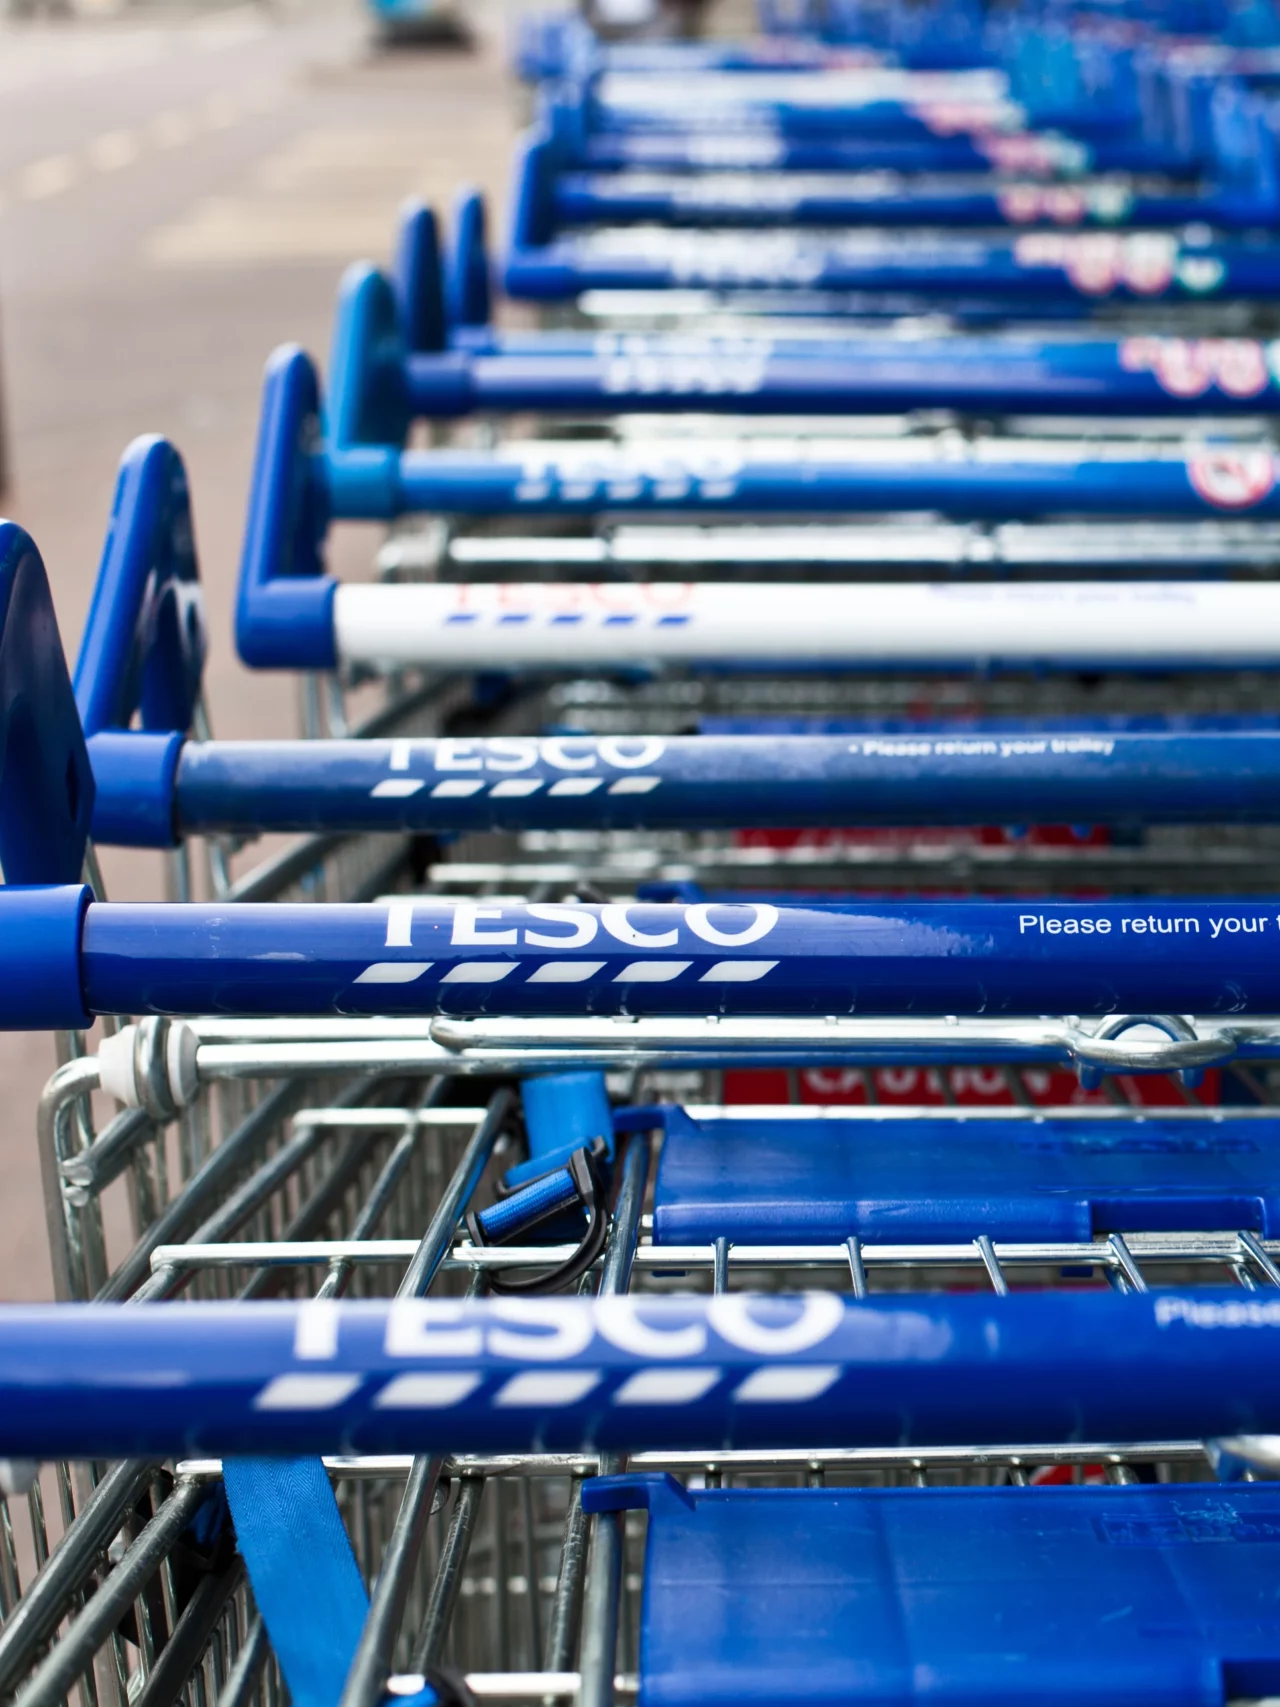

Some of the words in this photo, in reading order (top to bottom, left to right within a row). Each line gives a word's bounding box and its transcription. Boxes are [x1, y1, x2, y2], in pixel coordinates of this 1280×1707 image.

[388, 738, 667, 772] TESCO
[863, 741, 931, 756] Please
[935, 740, 997, 755] return
[1000, 740, 1047, 757] your
[1051, 738, 1114, 755] trolley
[384, 903, 780, 949] TESCO
[1019, 914, 1112, 934] Please
[1121, 914, 1200, 933] return
[1209, 914, 1268, 938] your
[294, 1291, 846, 1360] TESCO
